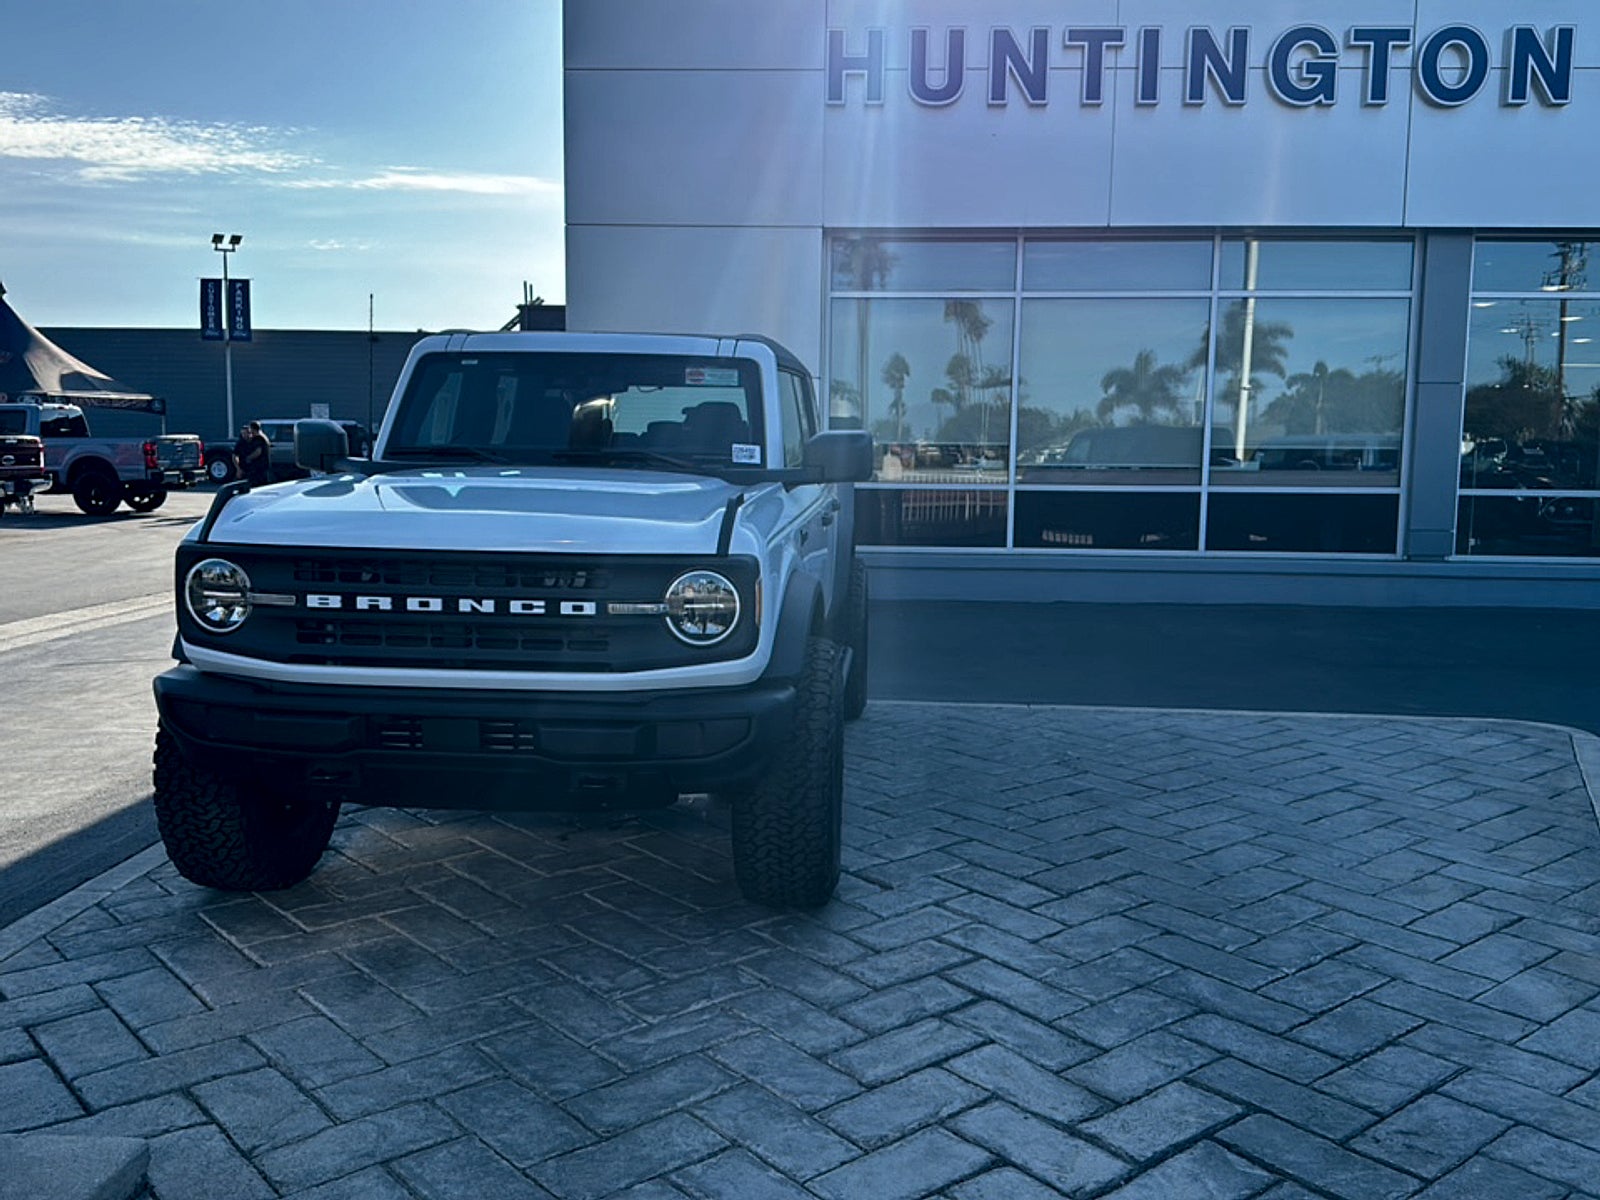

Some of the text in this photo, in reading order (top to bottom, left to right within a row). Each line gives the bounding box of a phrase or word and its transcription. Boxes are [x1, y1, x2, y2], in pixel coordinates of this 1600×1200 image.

[825, 24, 1577, 108] HUNTINGTON
[235, 282, 243, 330] PARKING
[306, 594, 596, 615] BRONCO
